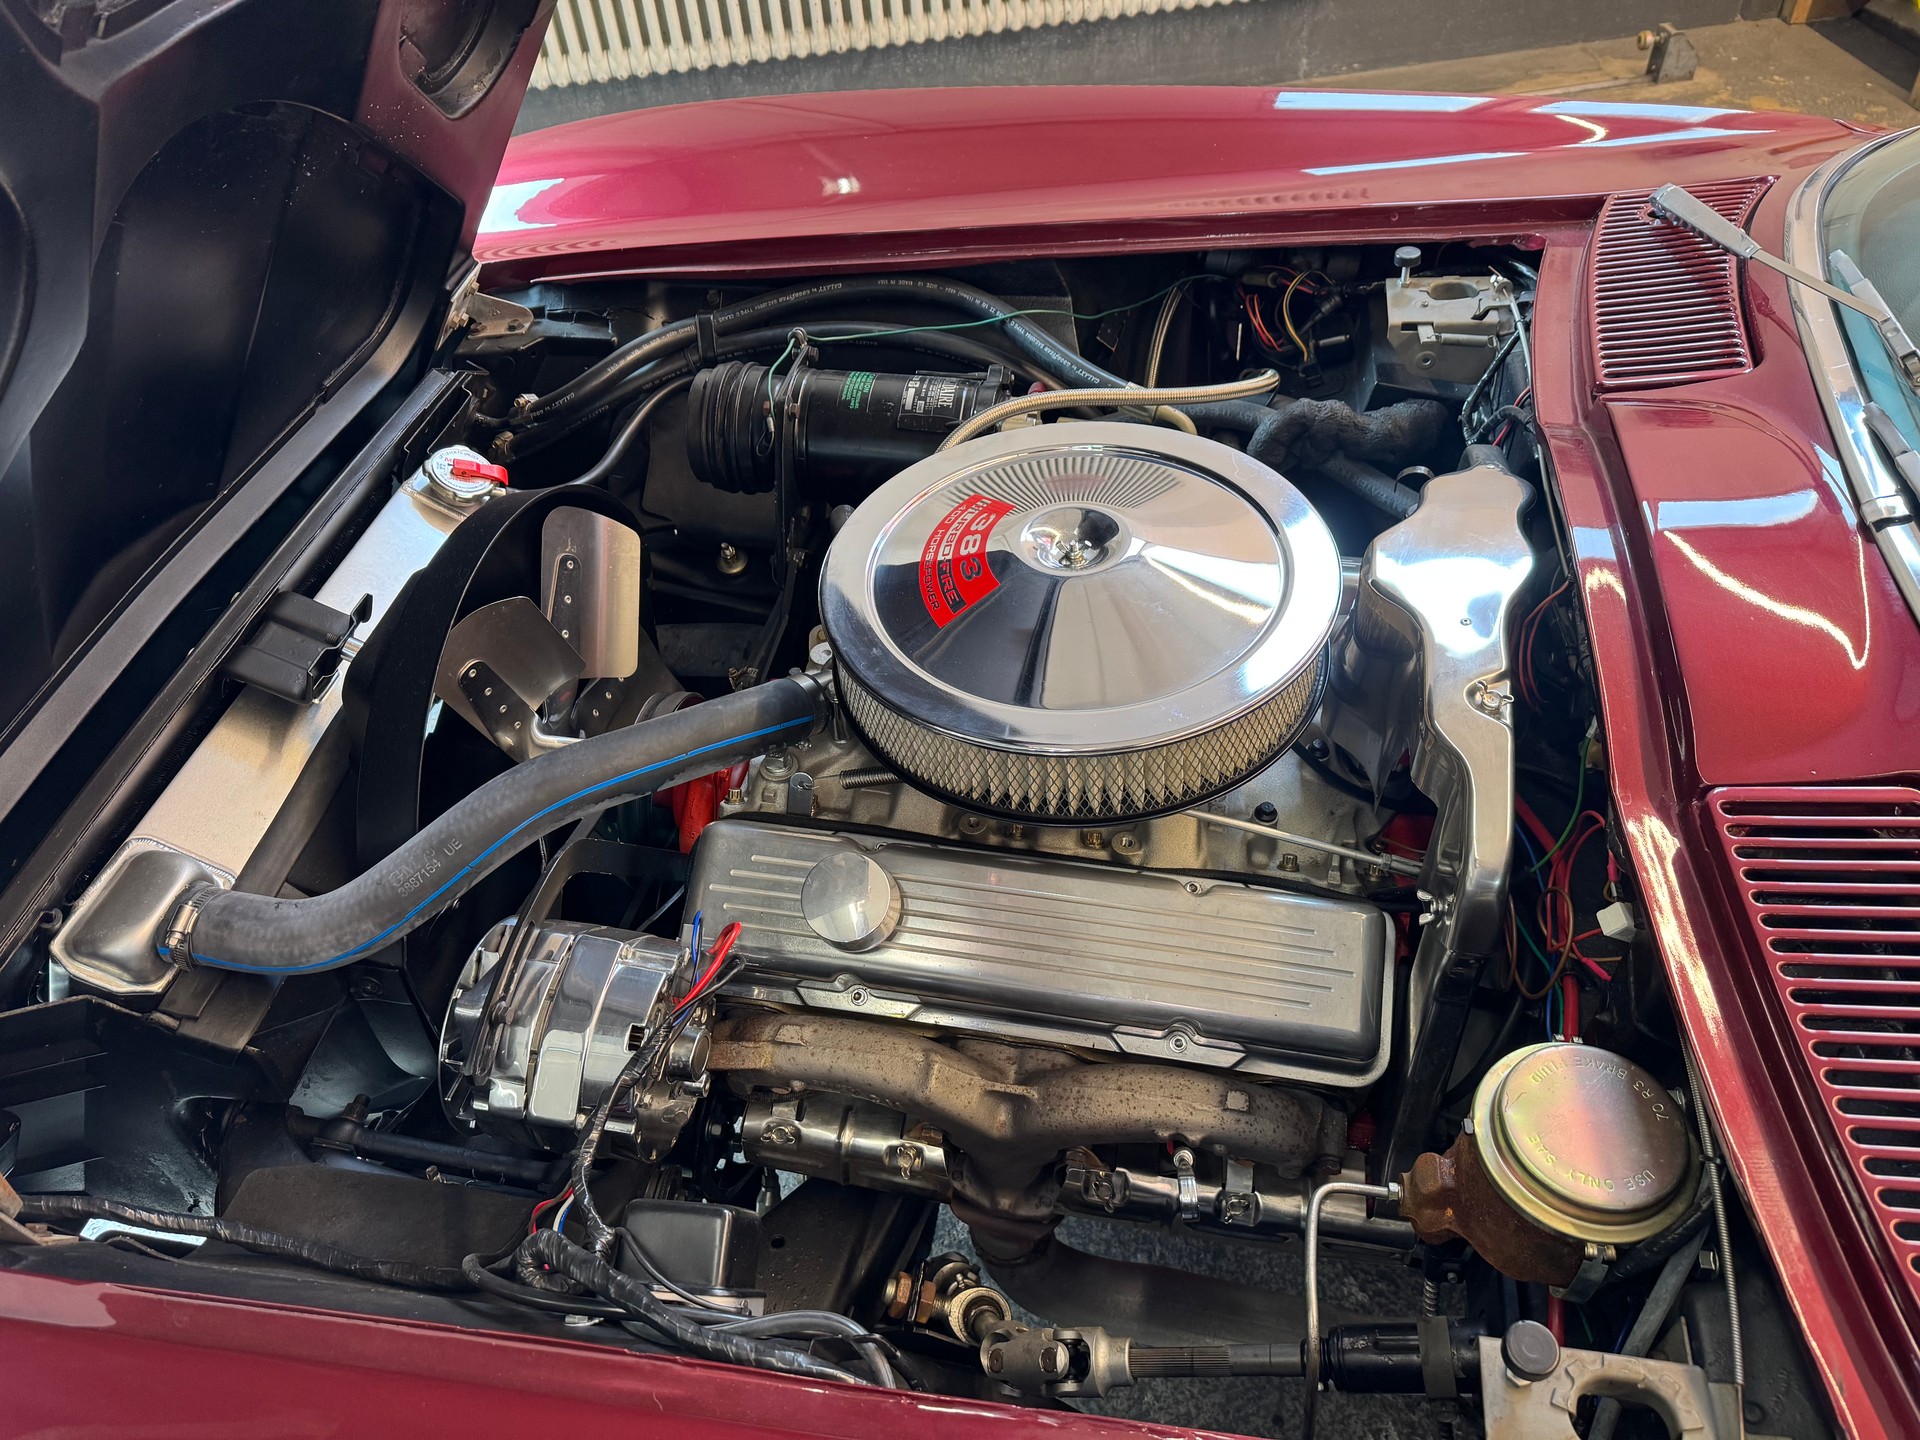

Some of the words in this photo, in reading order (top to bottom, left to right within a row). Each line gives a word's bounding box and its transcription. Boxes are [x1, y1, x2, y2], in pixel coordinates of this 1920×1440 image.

[948, 504, 967, 524] 400
[939, 505, 982, 606] TURBO-FIRE
[959, 511, 996, 582] 383
[923, 529, 945, 611] HORSEPOWER
[397, 858, 442, 898] 3887154
[443, 838, 463, 857] UE
[1531, 1056, 1569, 1085] FLUID
[1572, 1055, 1628, 1080] BRAKE
[1633, 1080, 1653, 1101] R3
[1527, 1134, 1557, 1166] SAE
[1565, 1168, 1615, 1194] ONLY
[1625, 1168, 1656, 1192] USE
